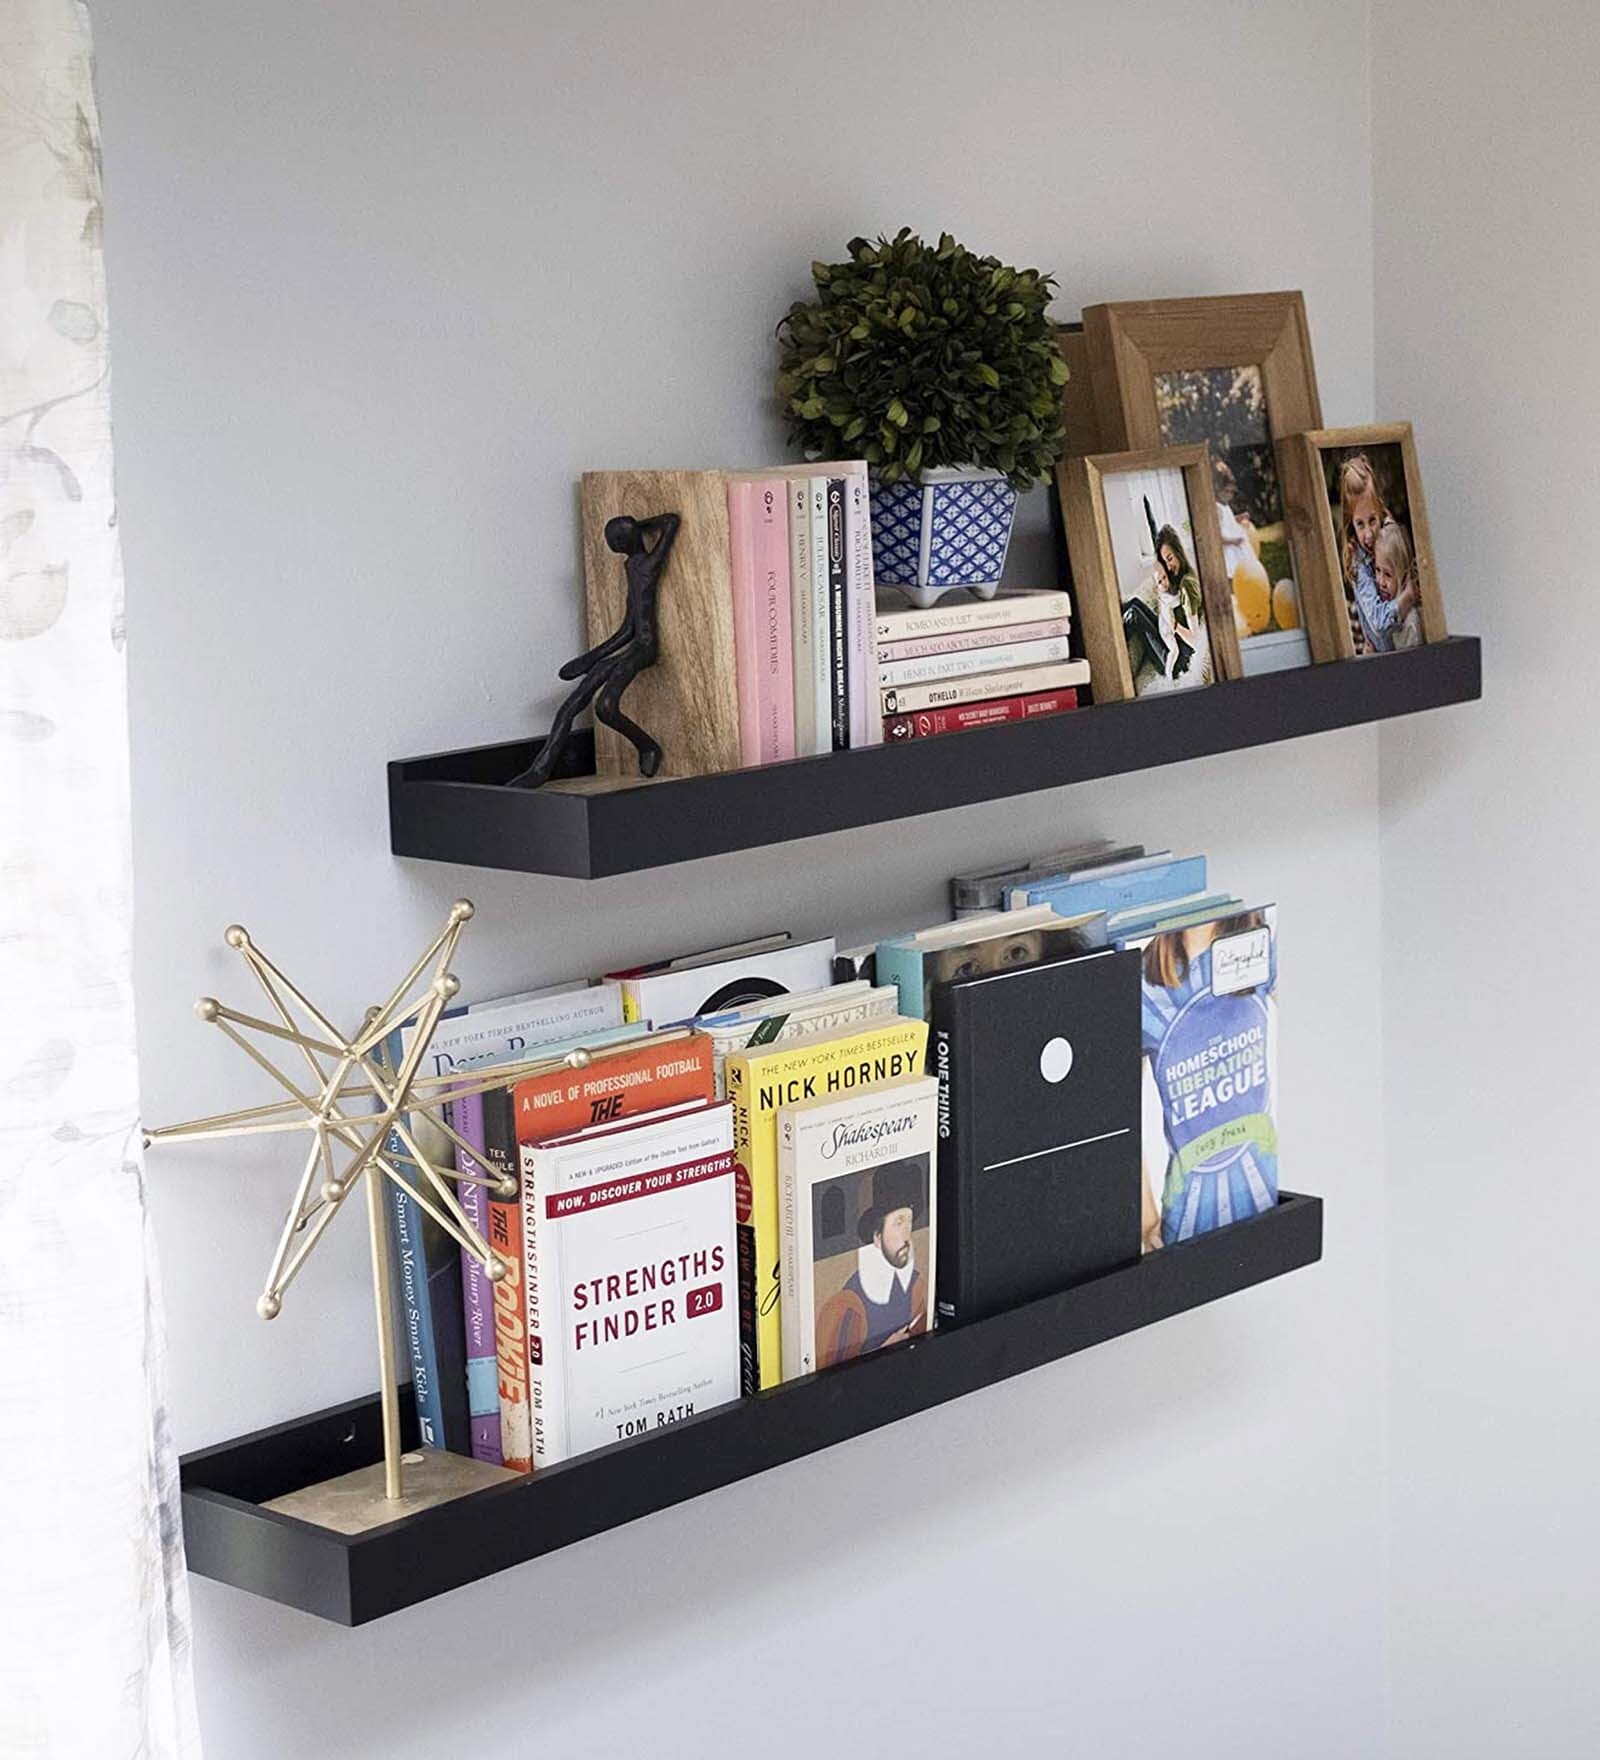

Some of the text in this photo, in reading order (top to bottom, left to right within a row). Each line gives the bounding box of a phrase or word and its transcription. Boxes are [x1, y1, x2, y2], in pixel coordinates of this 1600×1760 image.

[834, 591, 843, 638] MIDSUMMER
[770, 605, 779, 675] COMEDIES
[929, 690, 957, 703] OTHELLO
[573, 1006, 605, 1018] AUTHOR
[761, 1032, 916, 1076] THE NEW YORK TIMES BESTSELLER
[937, 1041, 949, 1081] ONE
[1166, 1026, 1265, 1082] HOMESCHOOL
[1168, 1043, 1265, 1100] LIBERATION
[523, 1057, 702, 1111] A NOVEL OF PROFESSIONAL FOOTBALL
[760, 1050, 918, 1111] NICK HORNBY
[1171, 1060, 1266, 1126] LEAGUE
[590, 1093, 624, 1123] THE
[739, 1107, 749, 1148] NICK
[939, 1084, 950, 1139] THING
[489, 1148, 507, 1159] TEX
[820, 1114, 918, 1160] Shakespeare
[845, 1145, 888, 1167] RICHARD
[557, 1156, 732, 1212] NOW, DISCOVER YOUR STRENGTHS
[595, 1161, 623, 1175] UPGRADED
[492, 1207, 509, 1247] THE
[523, 1157, 540, 1330] STRENGTHSFINDER
[395, 1191, 430, 1404] Smart Money Smart Kids
[573, 1245, 725, 1311] STRENGTHS
[470, 1312, 483, 1347] River
[574, 1291, 714, 1350] FINDER 2.0
[533, 1380, 545, 1456] TOM RATH
[616, 1403, 694, 1439] TOM RATH
